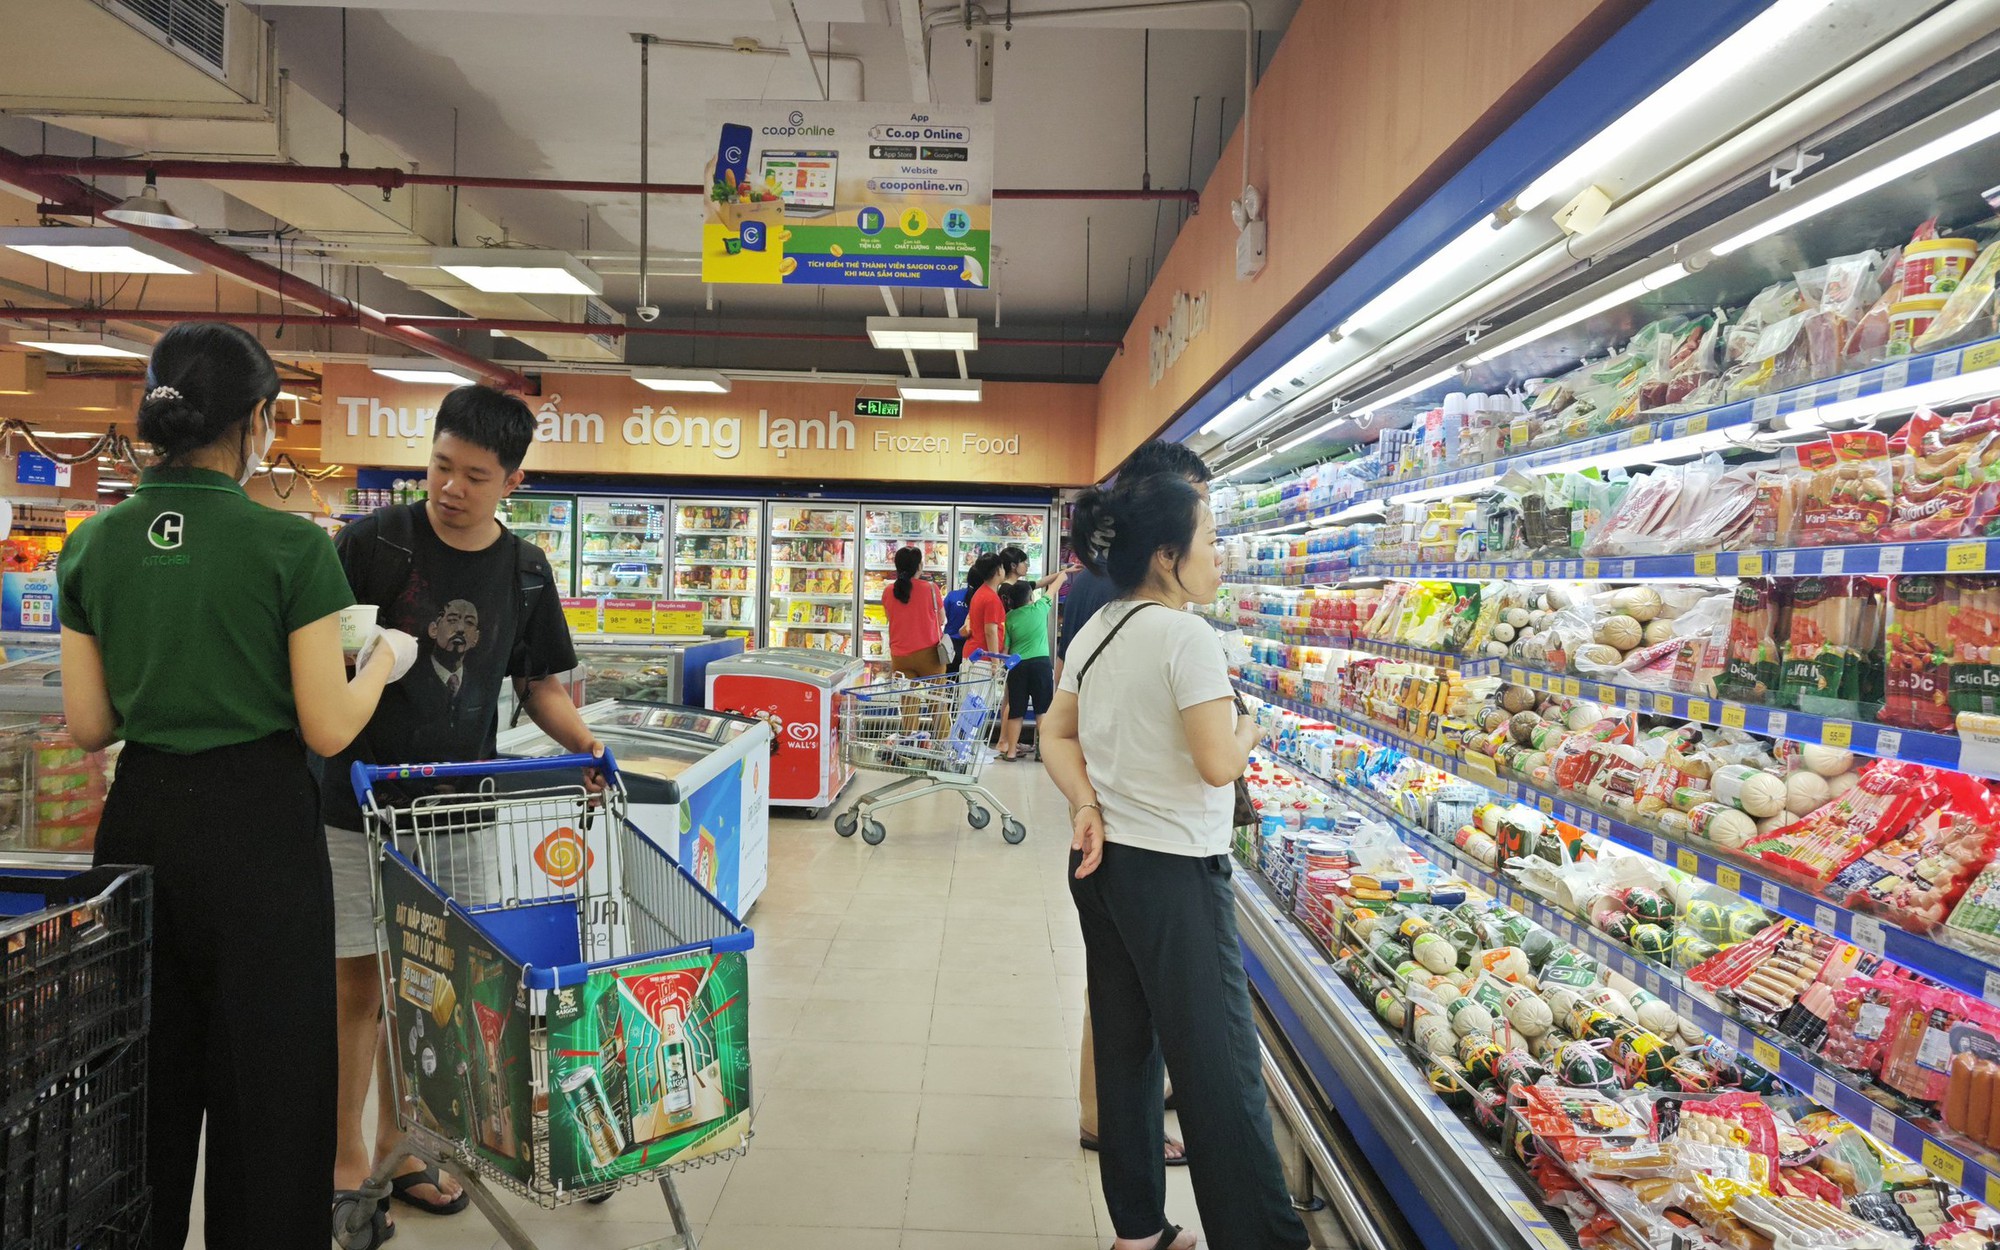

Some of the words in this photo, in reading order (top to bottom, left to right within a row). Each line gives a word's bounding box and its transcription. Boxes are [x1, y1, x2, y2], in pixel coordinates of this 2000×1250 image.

[910, 113, 929, 122] App
[886, 128, 919, 140] Co.op
[923, 129, 963, 139] Online
[901, 166, 938, 174] Website
[880, 180, 962, 191] cooponline.vn
[861, 261, 887, 269] THÀNH
[877, 270, 893, 278] SẮM
[894, 271, 921, 279] ONLINE
[337, 396, 436, 448] Thự
[533, 393, 605, 443] ẩm
[622, 405, 742, 458] đông
[759, 409, 856, 458] lạnh
[873, 430, 950, 453] Frozen
[962, 432, 1020, 455] Food
[142, 554, 190, 566] KITCHEN
[420, 912, 447, 941] SPECIAL
[403, 930, 420, 957] TRAO
[555, 1006, 578, 1016] SAIGON
